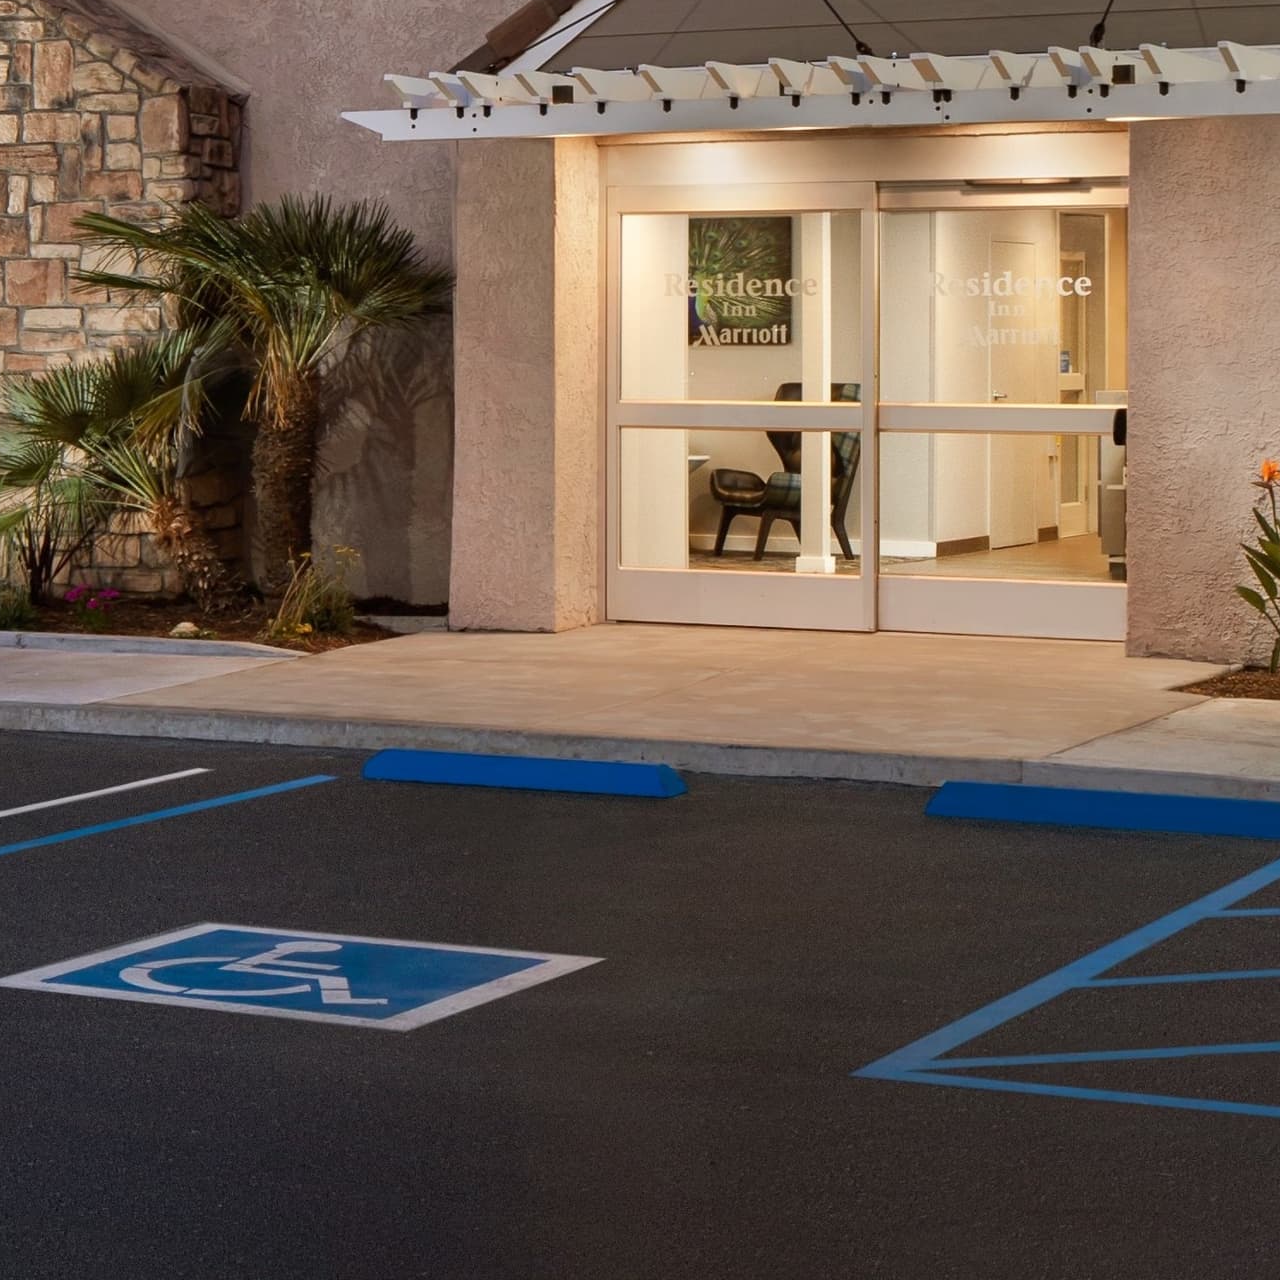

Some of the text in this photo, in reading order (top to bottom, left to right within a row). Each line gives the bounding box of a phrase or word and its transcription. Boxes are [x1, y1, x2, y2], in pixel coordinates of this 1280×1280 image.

[664, 272, 818, 297] Residence
[722, 302, 758, 317] Inn
[692, 324, 788, 346] Marriott
